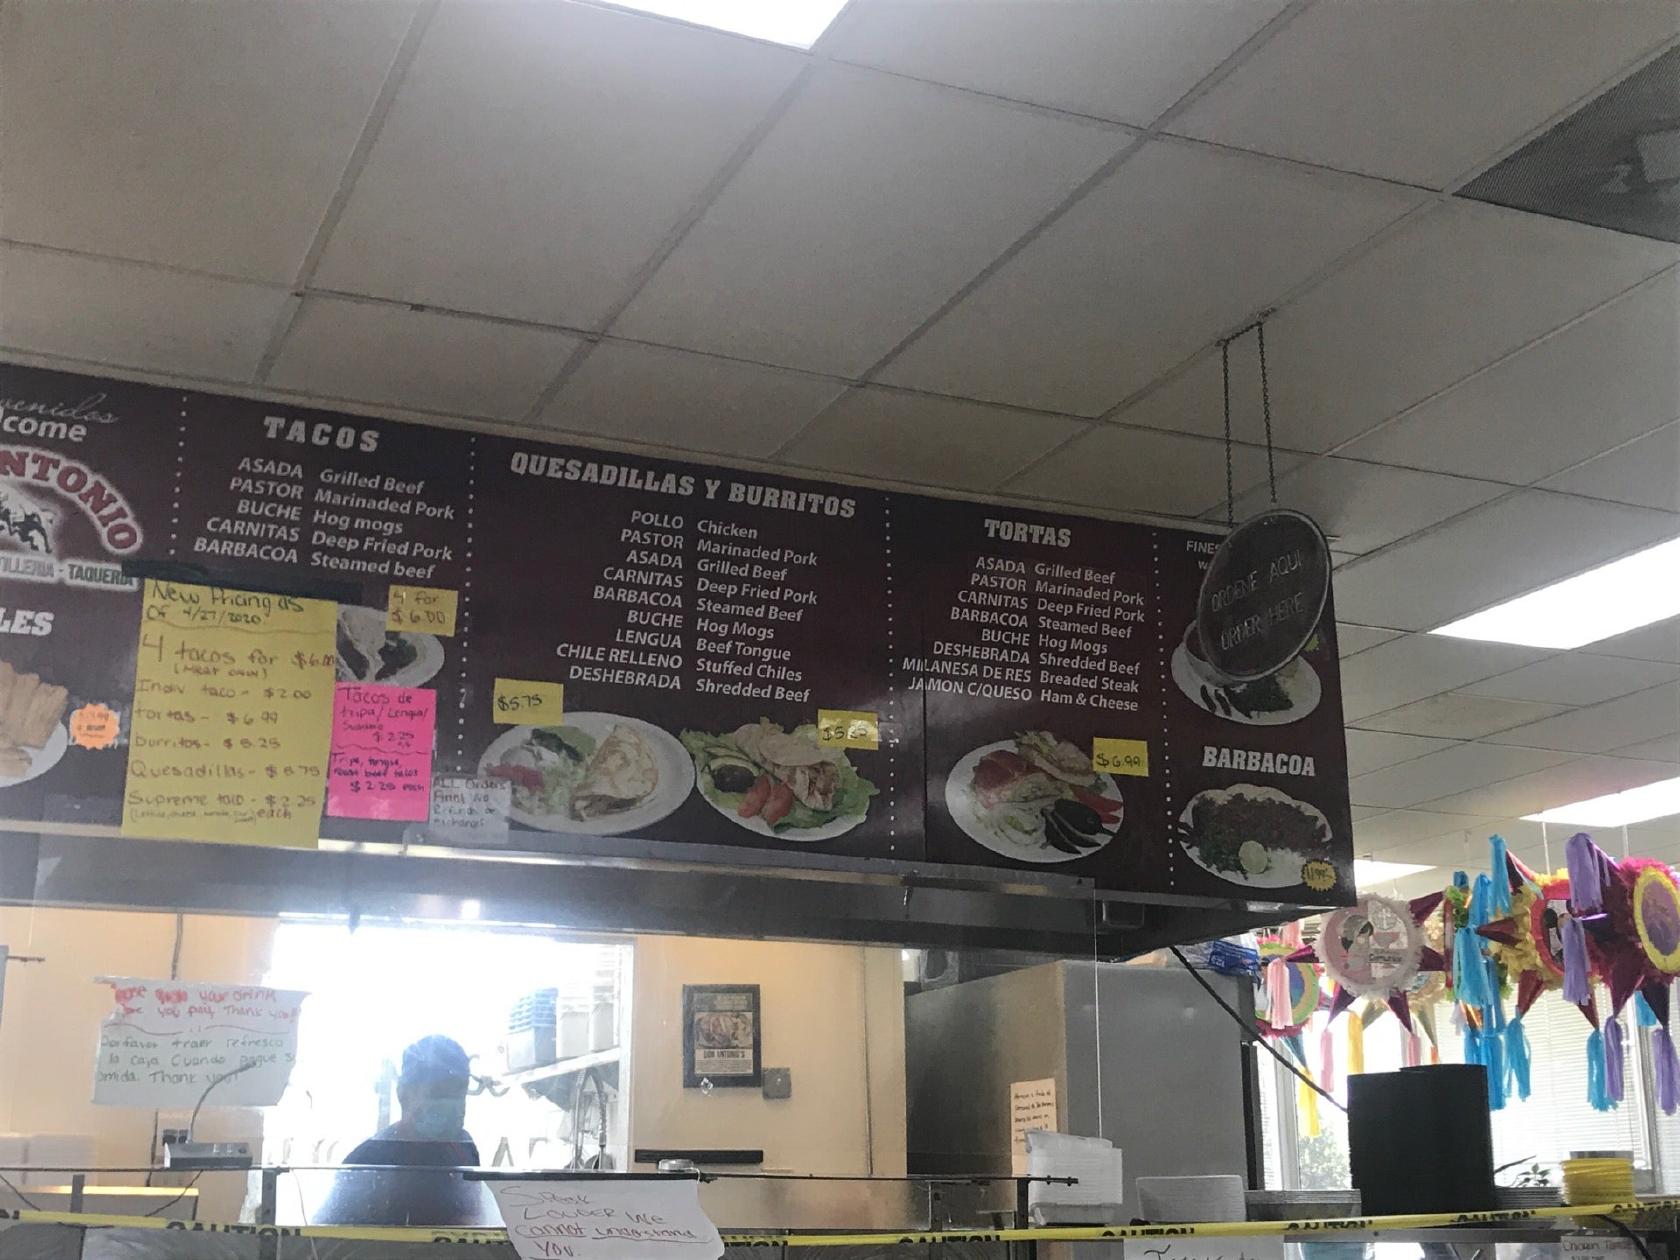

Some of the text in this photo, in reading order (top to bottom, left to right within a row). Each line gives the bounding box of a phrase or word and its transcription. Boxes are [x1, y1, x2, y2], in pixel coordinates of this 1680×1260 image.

[264, 415, 380, 453] TACOS
[238, 456, 426, 494] ASADA Grilled Beef
[510, 451, 856, 518] QUESADILLAS Y BURRITOS
[230, 477, 454, 520] PASTOR Marinaded Pork
[237, 499, 403, 535] BUCHE Hog mogs
[631, 510, 758, 539] POLLO Chicken
[984, 518, 1071, 547] TORTAS
[206, 516, 453, 561] CARNITAS Deep Fried Pork
[621, 528, 818, 566] PASTOR Marinaded Pork
[194, 538, 436, 578] BARBACOA Steamed beef
[626, 549, 788, 581] ASADA Grilled Beef
[976, 556, 1116, 585] ASADA Grilled Beef
[1269, 550, 1302, 584] AQUI
[153, 580, 199, 603] New
[211, 586, 272, 617] Pricing
[603, 567, 818, 605] CARNITAS Deep Fried Pork
[971, 573, 1144, 606] PASTOR Marinaded Pork
[593, 585, 804, 623] BARBACOA Steamed Beef
[957, 590, 1145, 623] CARNITAS Deep Fried Pork
[627, 610, 774, 640] BUCHE Hog Mogs
[950, 606, 1132, 639] BARBACOA Steamed Beef
[1220, 592, 1305, 651] ORDER HERE
[143, 633, 164, 662] 4
[175, 640, 235, 665] tacos
[248, 647, 279, 665] for
[616, 628, 791, 661] LENGUA Beef Tongue
[933, 641, 1140, 675] DESHEBRADA Shredded Beef
[981, 628, 1107, 655] BUCHE Hog Mogs
[557, 642, 802, 682] CHILE RELLENO Stuffed Chiles
[983, 665, 1002, 680] DE
[1005, 668, 1031, 683] RES
[1040, 670, 1098, 689] Breaded
[1101, 677, 1139, 693] Steak
[337, 685, 412, 705] Tacos de
[569, 665, 811, 704] DESHEBRADA Shredded Beef
[908, 677, 1138, 711] JAMON C/QUESO Ham & Cheese
[497, 694, 543, 711] $5.75
[1096, 753, 1141, 769] $6.99
[1201, 745, 1316, 777] BARBACOA
